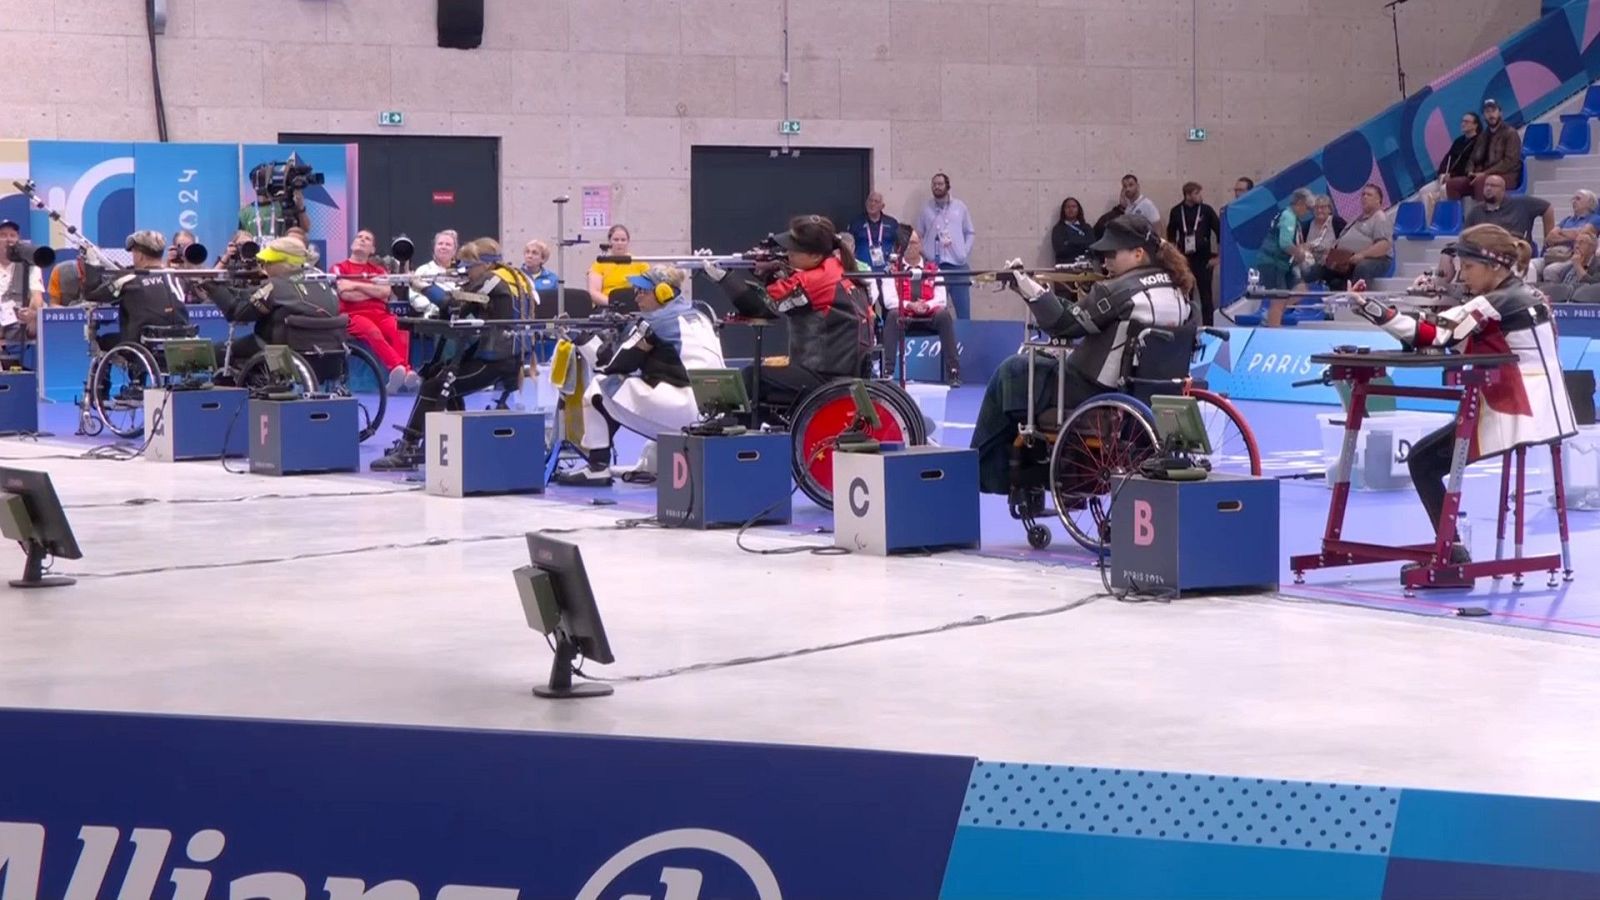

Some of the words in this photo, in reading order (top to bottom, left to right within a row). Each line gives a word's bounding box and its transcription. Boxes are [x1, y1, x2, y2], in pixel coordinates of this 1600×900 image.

[142, 276, 164, 286] SVK
[1139, 273, 1172, 286] KORE
[260, 415, 269, 445] F
[440, 434, 448, 466] E
[673, 452, 688, 489] D
[849, 477, 870, 518] C
[1134, 500, 1155, 546] B
